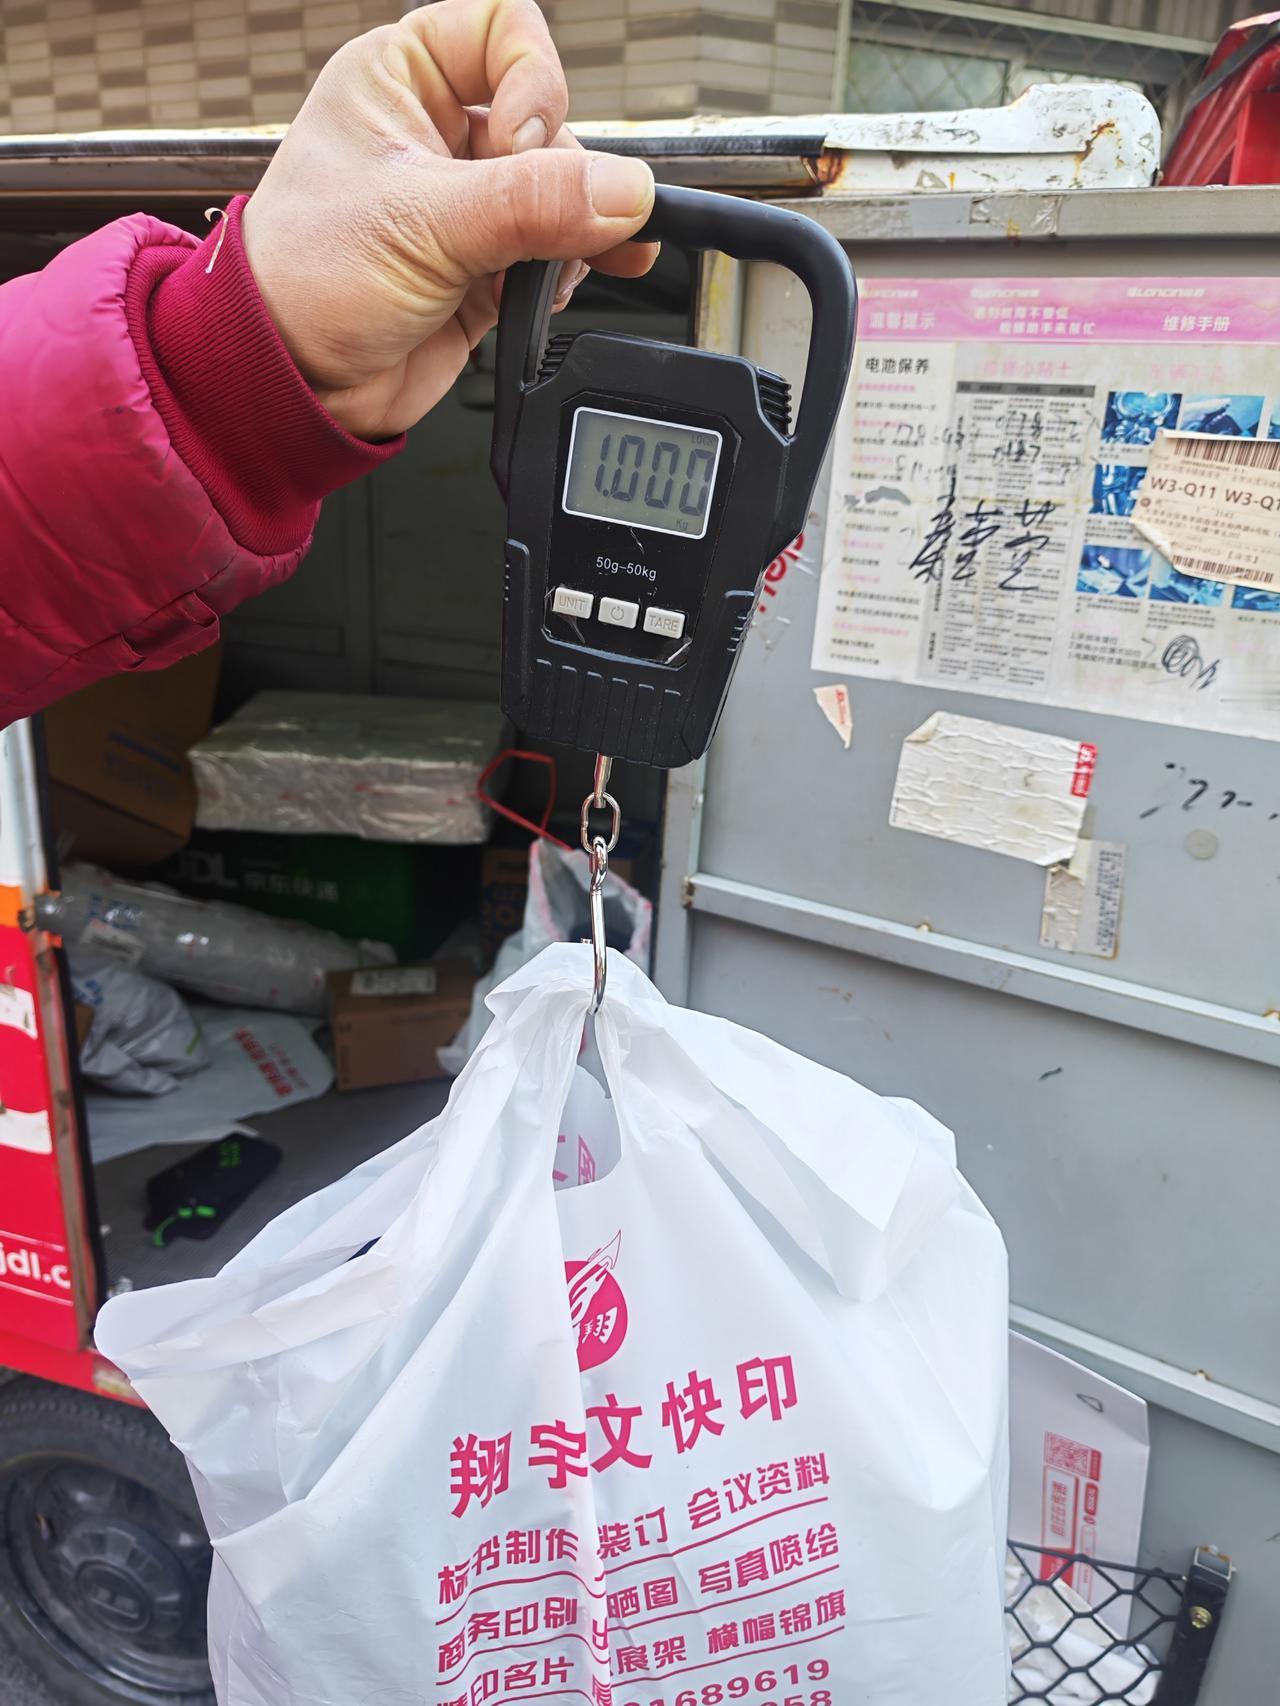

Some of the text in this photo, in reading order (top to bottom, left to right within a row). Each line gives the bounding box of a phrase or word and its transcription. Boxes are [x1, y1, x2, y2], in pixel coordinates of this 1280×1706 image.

[1162, 315, 1231, 332] 维修手册
[865, 357, 930, 376] 电池保养
[594, 433, 716, 517] 1.000
[1150, 476, 1217, 500] W3-Q11
[596, 556, 657, 581] 50g-50kg
[557, 596, 587, 611] UNIT
[648, 615, 680, 632] TARE
[450, 1354, 798, 1518] 翔宇文快印
[437, 1452, 831, 1605] 标书制作 装订 会议资料
[438, 1596, 578, 1674] 商务印刷
[607, 1575, 680, 1620] 晒图
[698, 1522, 840, 1595] 写真喷绘
[608, 1634, 686, 1677] 展架
[707, 1588, 847, 1654] 横幅锦旗
[624, 1658, 831, 1706] 689619
[760, 1690, 833, 1706] 58
